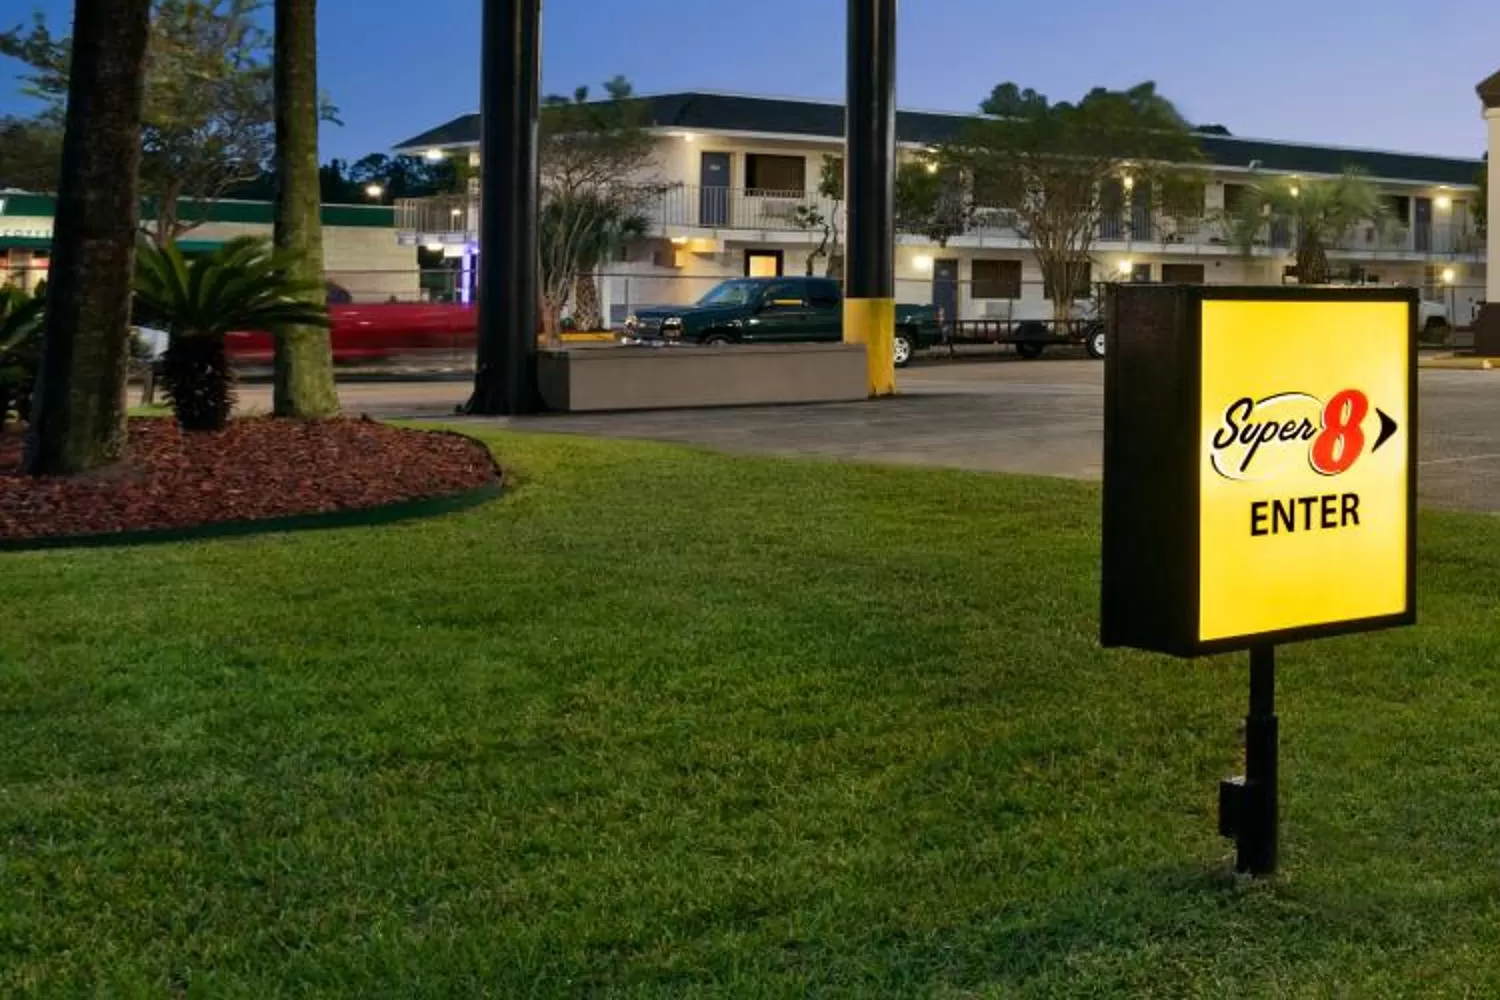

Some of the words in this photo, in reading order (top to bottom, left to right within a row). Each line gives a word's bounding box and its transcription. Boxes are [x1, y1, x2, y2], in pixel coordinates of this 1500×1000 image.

[1213, 397, 1318, 472] Super
[1309, 388, 1369, 476] 8
[1250, 493, 1361, 536] ENTER
